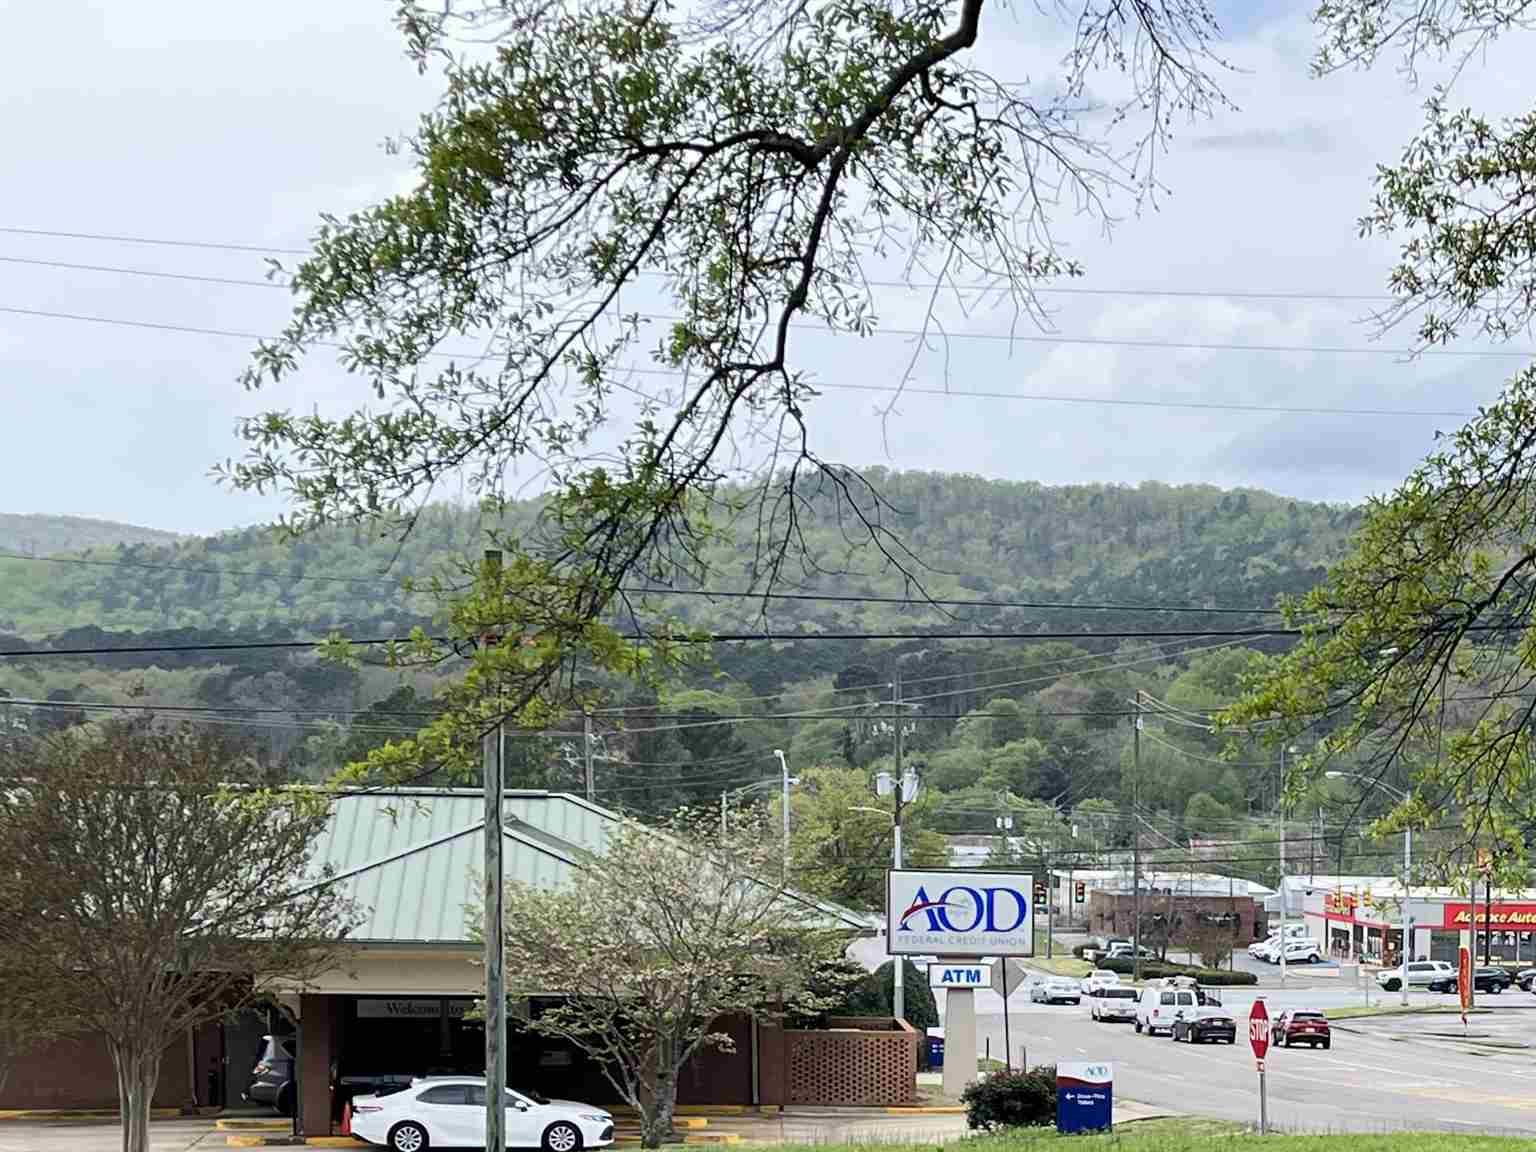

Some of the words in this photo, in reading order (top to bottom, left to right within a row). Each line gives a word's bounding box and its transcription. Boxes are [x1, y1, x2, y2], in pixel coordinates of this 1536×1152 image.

[897, 885, 1027, 933] AOD
[898, 935, 942, 945] FEDERAL
[948, 935, 987, 946] CREDIT
[990, 936, 1026, 946] UNION
[941, 969, 981, 983] ATM
[1249, 1018, 1269, 1041] STOP
